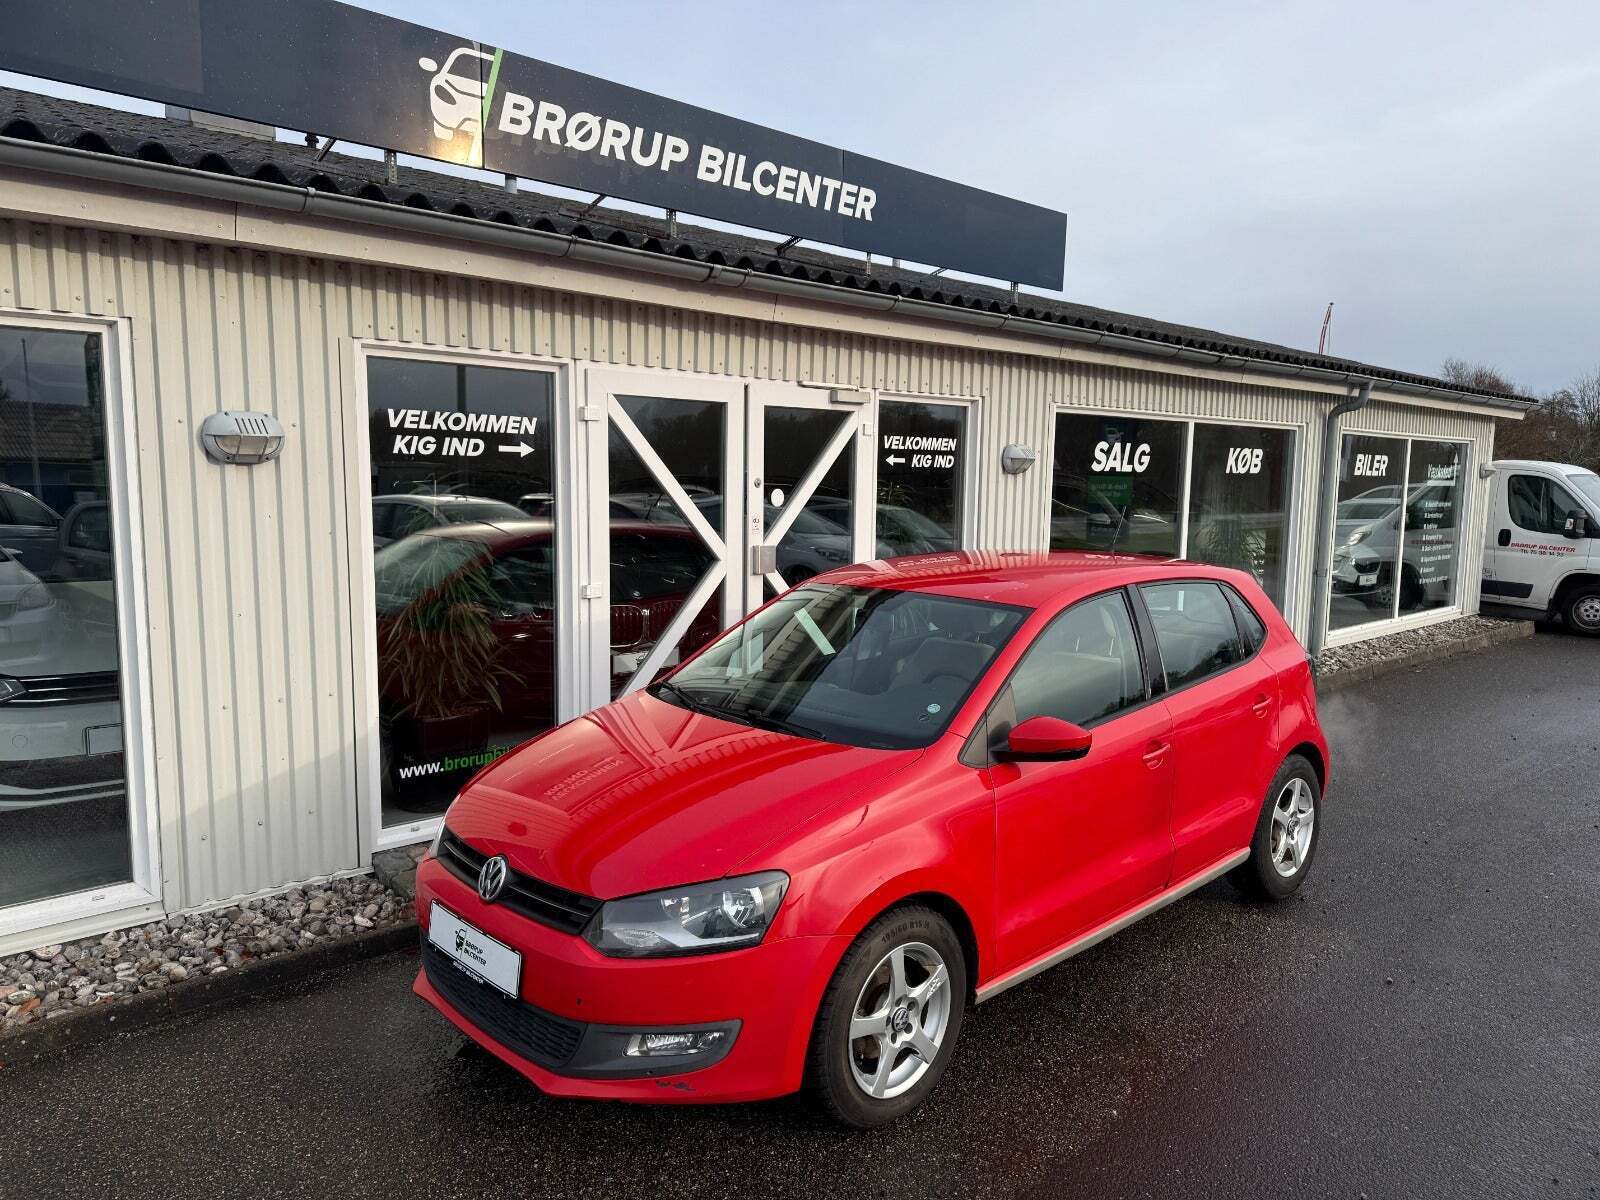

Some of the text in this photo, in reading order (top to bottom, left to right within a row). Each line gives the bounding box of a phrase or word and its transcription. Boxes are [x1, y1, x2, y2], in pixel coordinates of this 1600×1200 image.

[497, 91, 878, 222] BRØRUP BILCENTER
[387, 408, 538, 435] VELKOMMEN
[392, 434, 485, 457] KIG IND
[883, 435, 958, 452] VELKOMMEN
[911, 454, 955, 468] KIG IND
[1090, 440, 1151, 473] SALG
[1225, 447, 1264, 474] KØB
[1353, 453, 1389, 477] BILER
